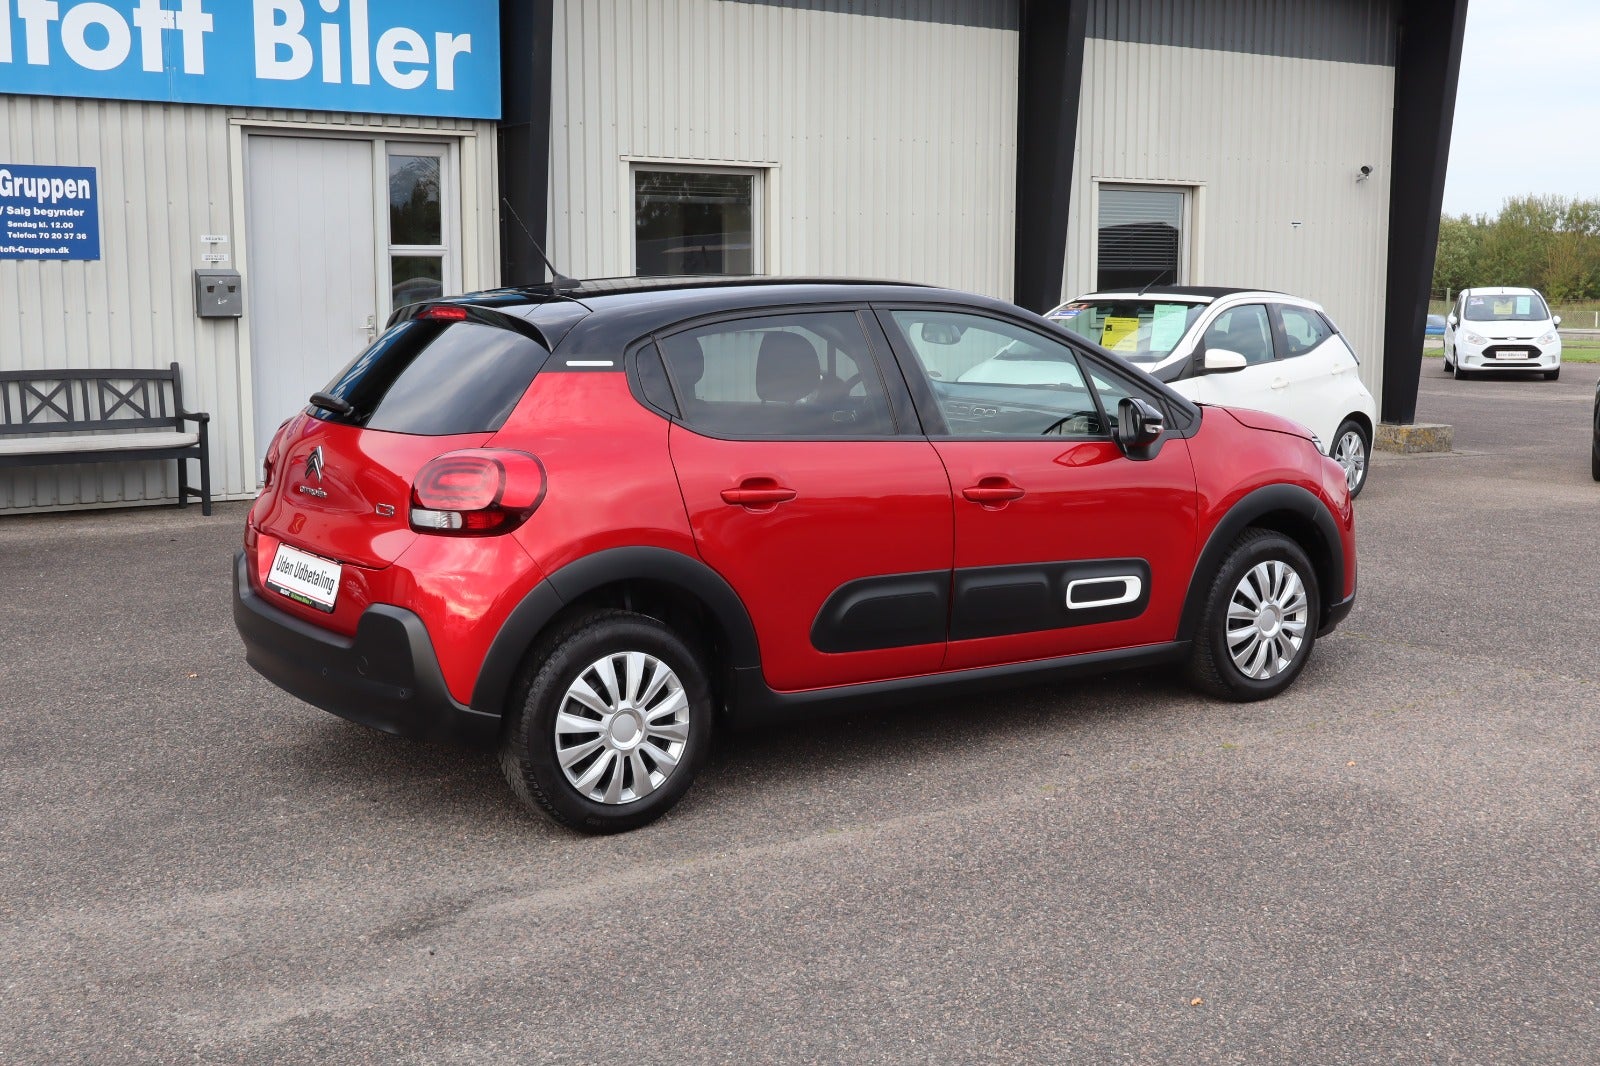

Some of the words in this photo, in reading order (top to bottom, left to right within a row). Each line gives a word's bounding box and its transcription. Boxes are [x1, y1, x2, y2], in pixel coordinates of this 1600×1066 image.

[252, 0, 472, 91] Biler
[0, 169, 90, 203] Gruppen
[7, 206, 31, 216] Salg
[34, 207, 84, 217] begynder
[51, 232, 62, 240] 20
[276, 555, 293, 575] Uden
[294, 561, 335, 595] Udbetaling
